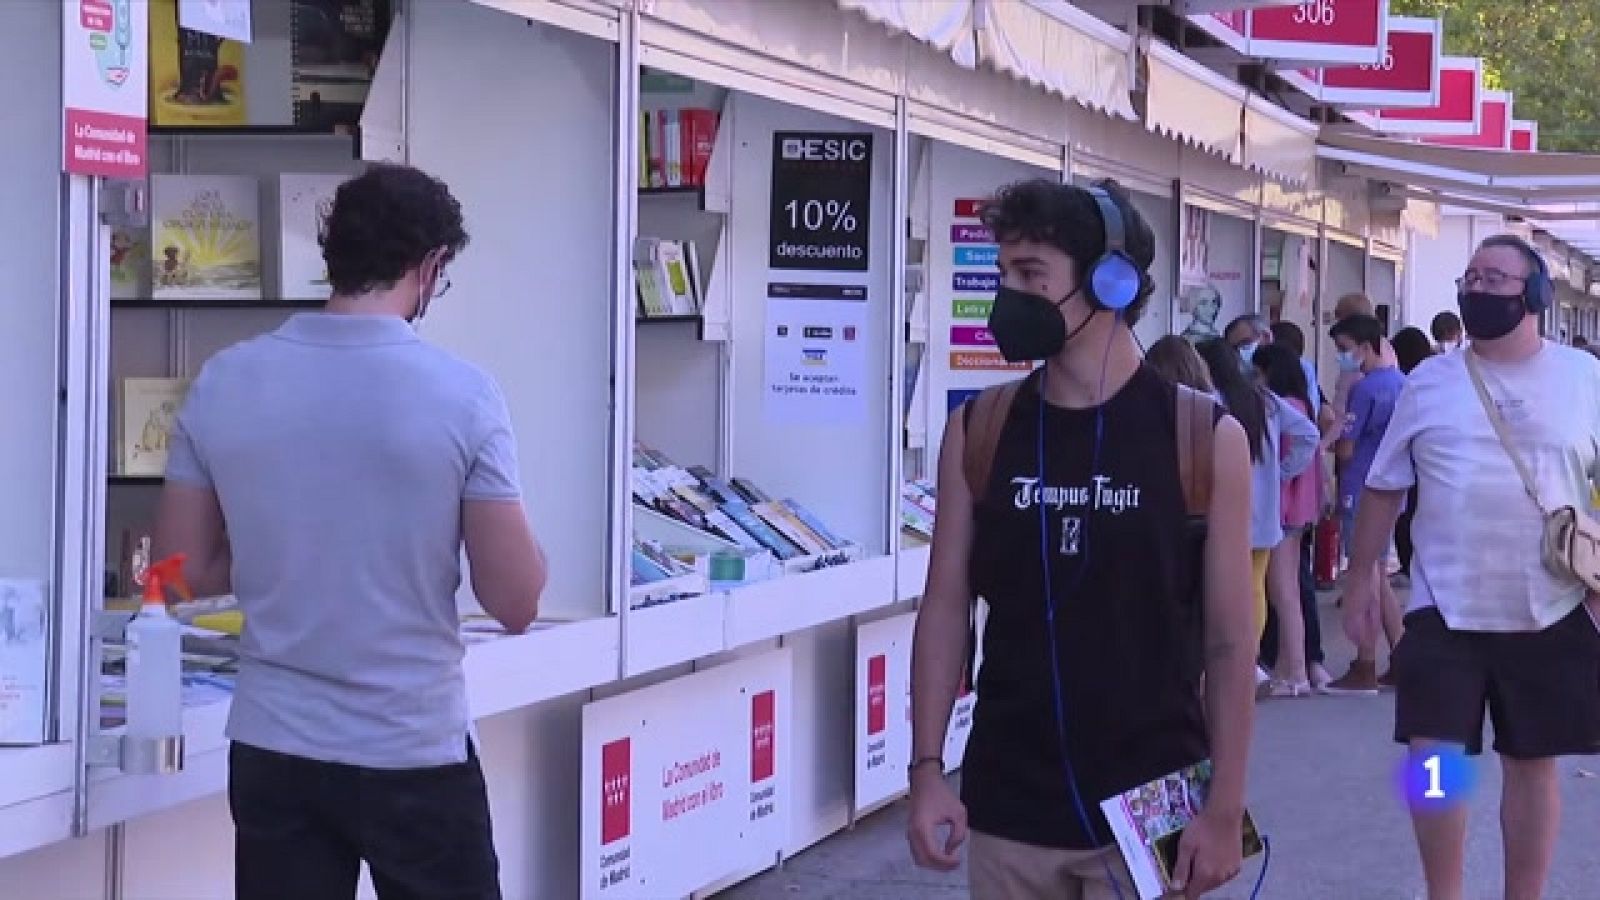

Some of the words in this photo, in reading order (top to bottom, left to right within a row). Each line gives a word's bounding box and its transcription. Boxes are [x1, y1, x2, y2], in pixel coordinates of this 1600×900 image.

[1292, 0, 1336, 26] 306
[804, 139, 866, 161] ESIC
[784, 199, 857, 231] 10%
[776, 241, 864, 260] descuento
[1010, 476, 1088, 511] Tempus
[1092, 475, 1140, 515] Fugit
